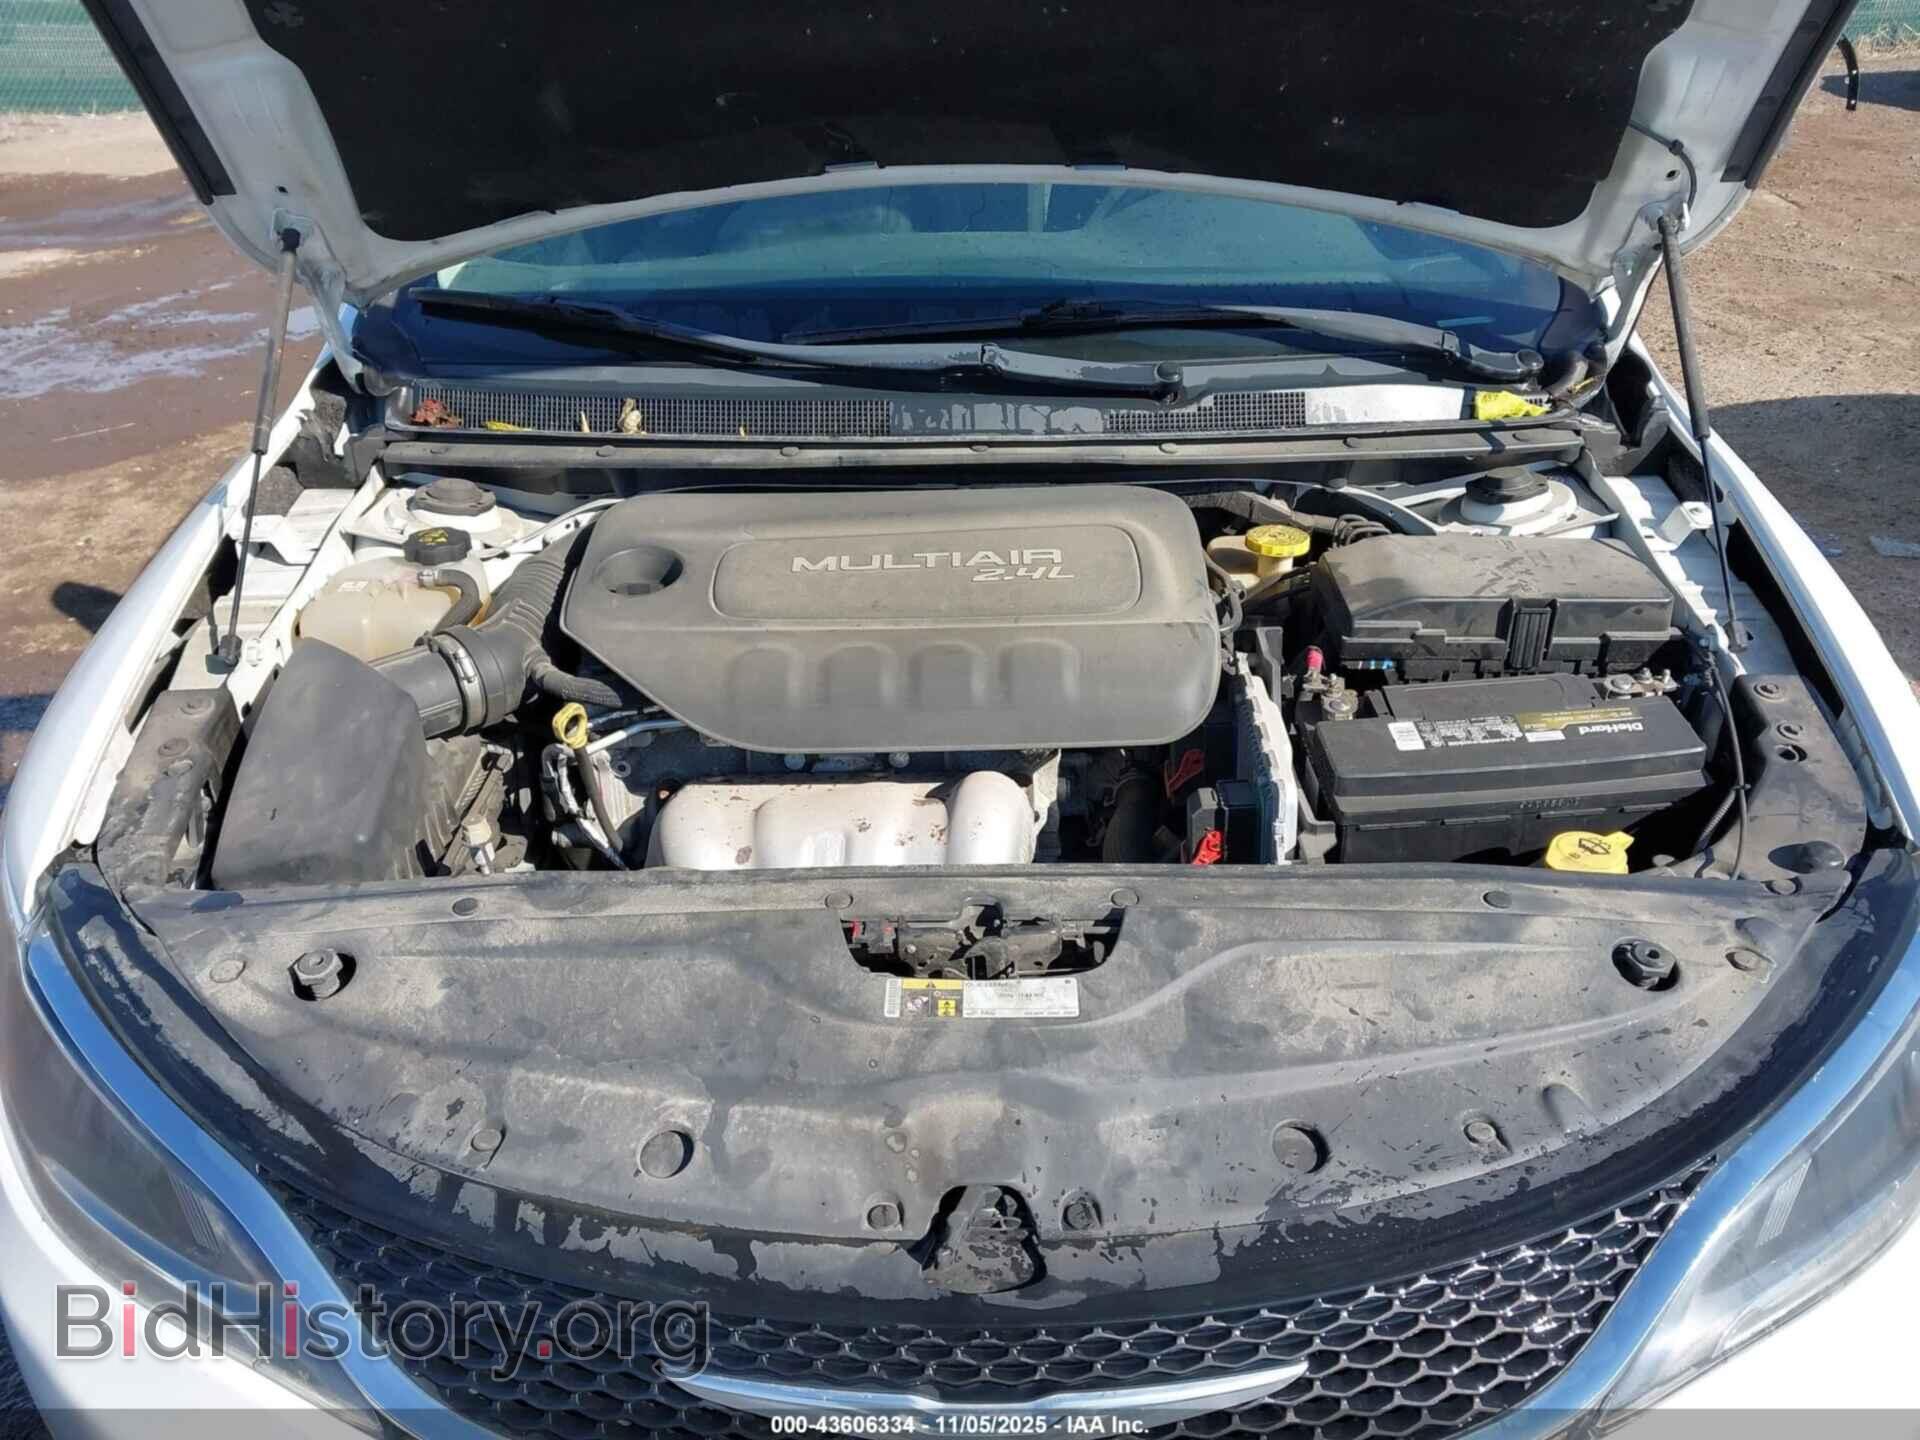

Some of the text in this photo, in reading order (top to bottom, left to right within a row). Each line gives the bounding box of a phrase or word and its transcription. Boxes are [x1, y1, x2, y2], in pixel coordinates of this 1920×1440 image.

[791, 548, 1063, 573] MULTIAIR
[972, 566, 1075, 583] 2.4L
[1578, 722, 1645, 736] DieHard
